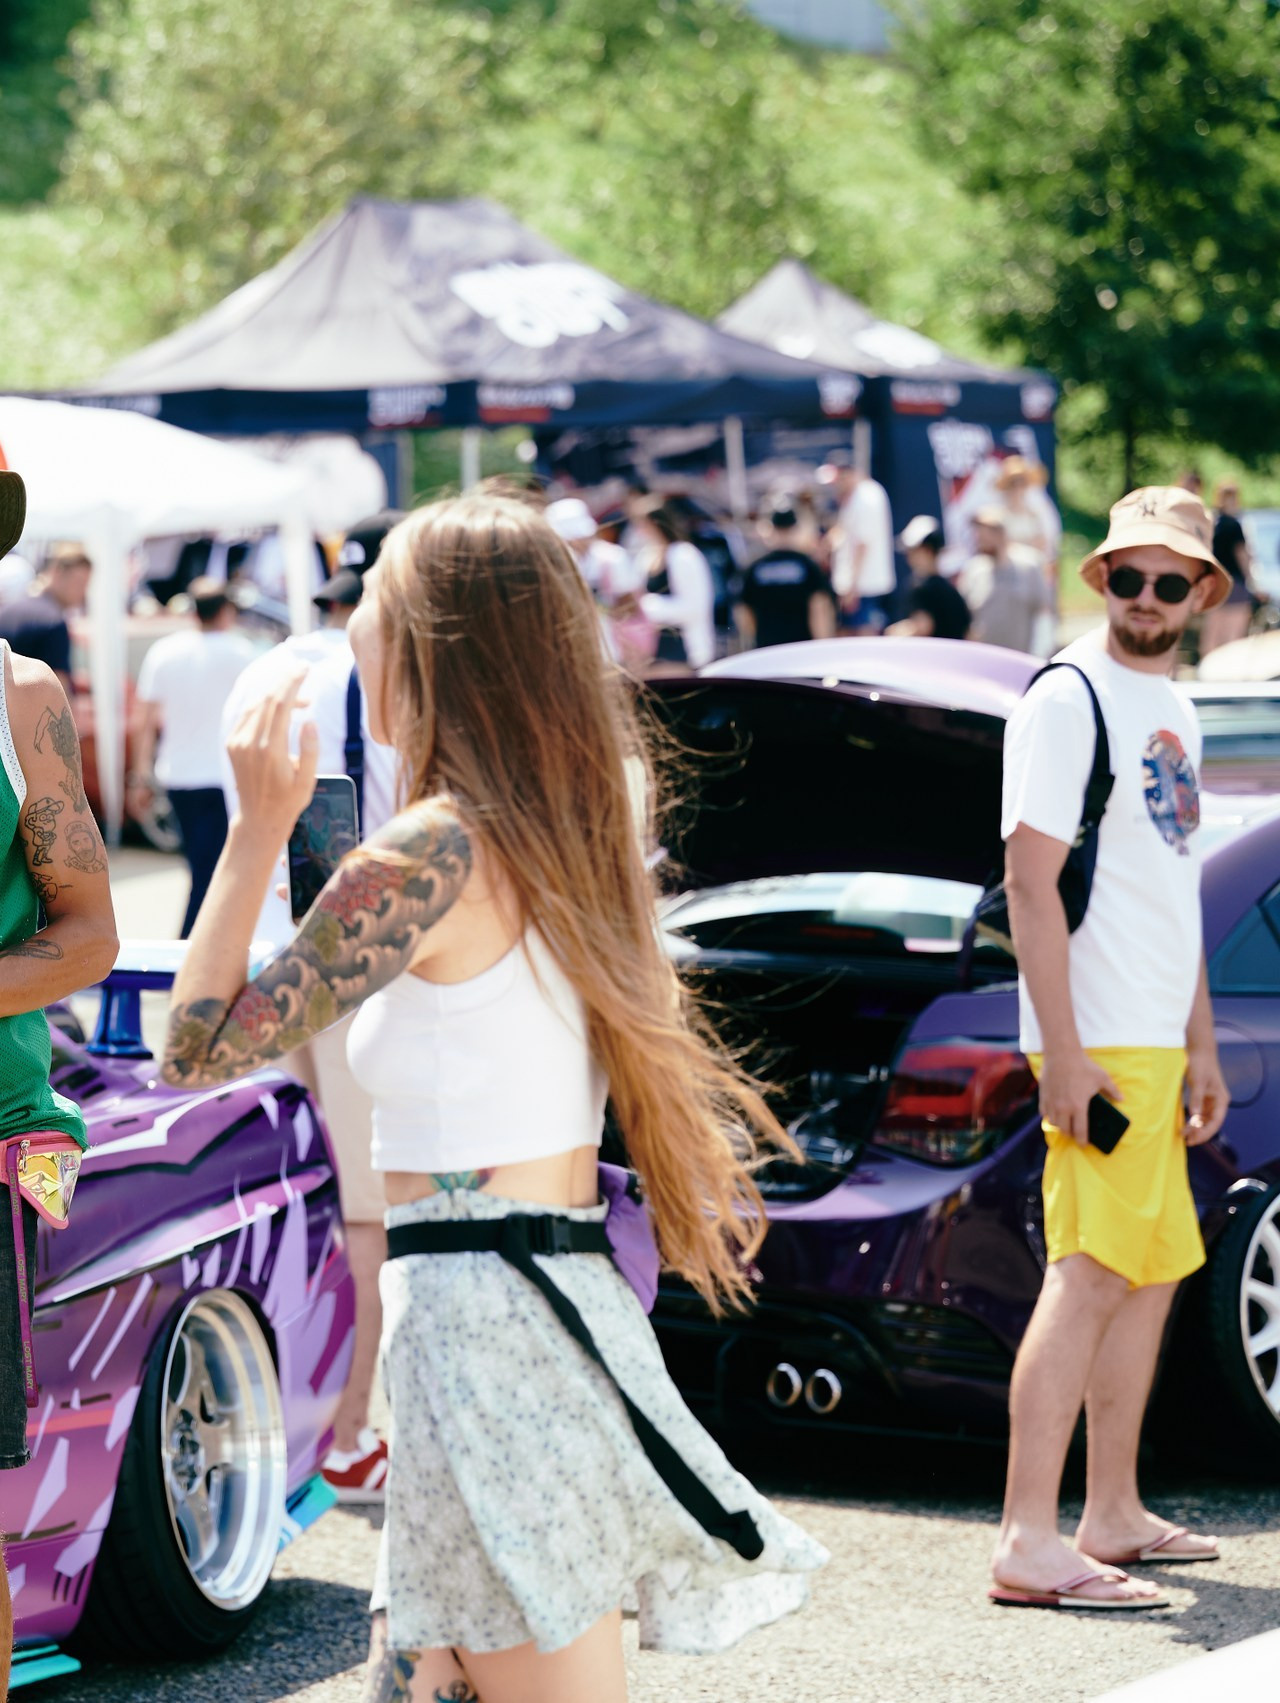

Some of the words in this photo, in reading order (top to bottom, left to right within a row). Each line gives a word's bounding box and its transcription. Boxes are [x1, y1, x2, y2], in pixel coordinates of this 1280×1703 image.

[8, 1167, 17, 1189] LOST
[11, 1191, 20, 1216] MARY
[17, 1253, 25, 1276] LOST
[19, 1278, 27, 1303] MARY
[23, 1341, 32, 1363] LOST
[26, 1365, 34, 1390] MARY
